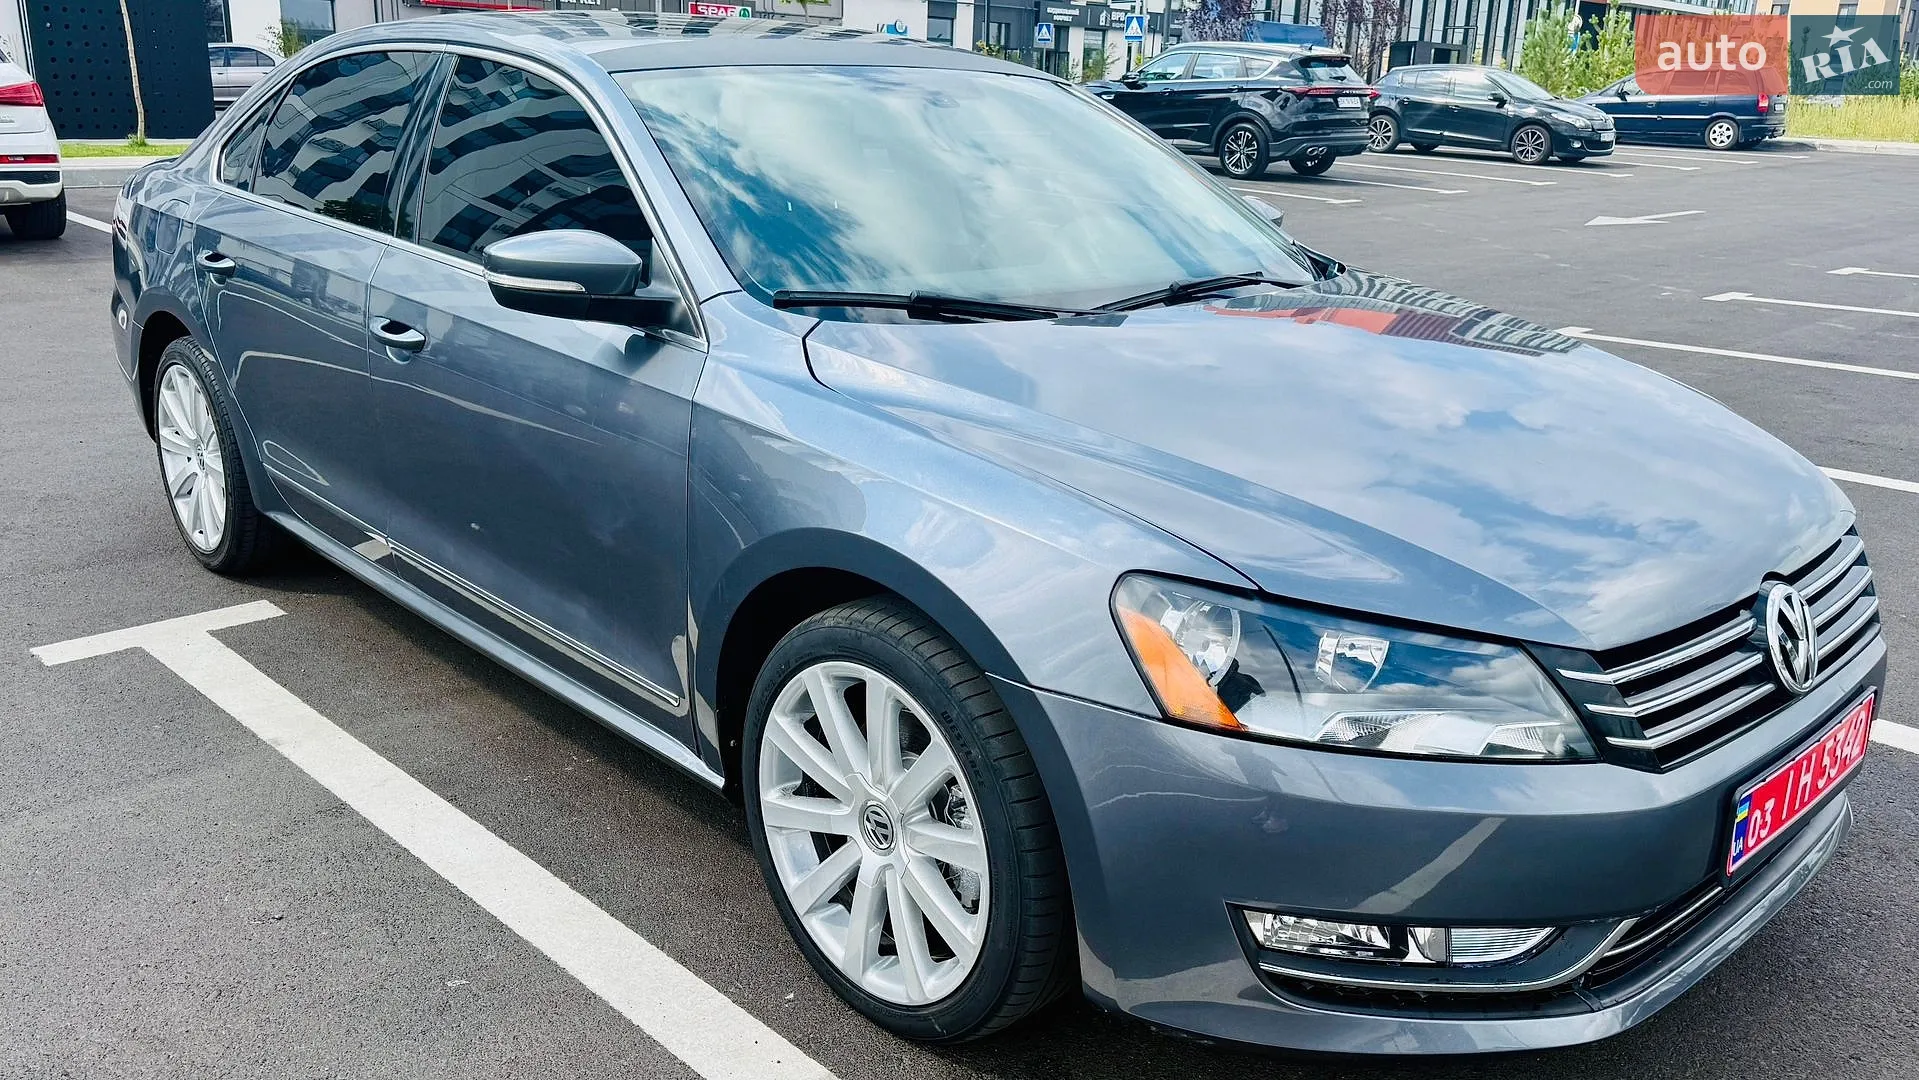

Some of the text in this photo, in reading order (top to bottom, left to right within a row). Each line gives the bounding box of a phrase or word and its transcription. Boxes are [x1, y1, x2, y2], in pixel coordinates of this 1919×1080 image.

[1747, 798, 1776, 848] 03
[1816, 710, 1866, 789] 5342
[1733, 837, 1744, 856] UA
